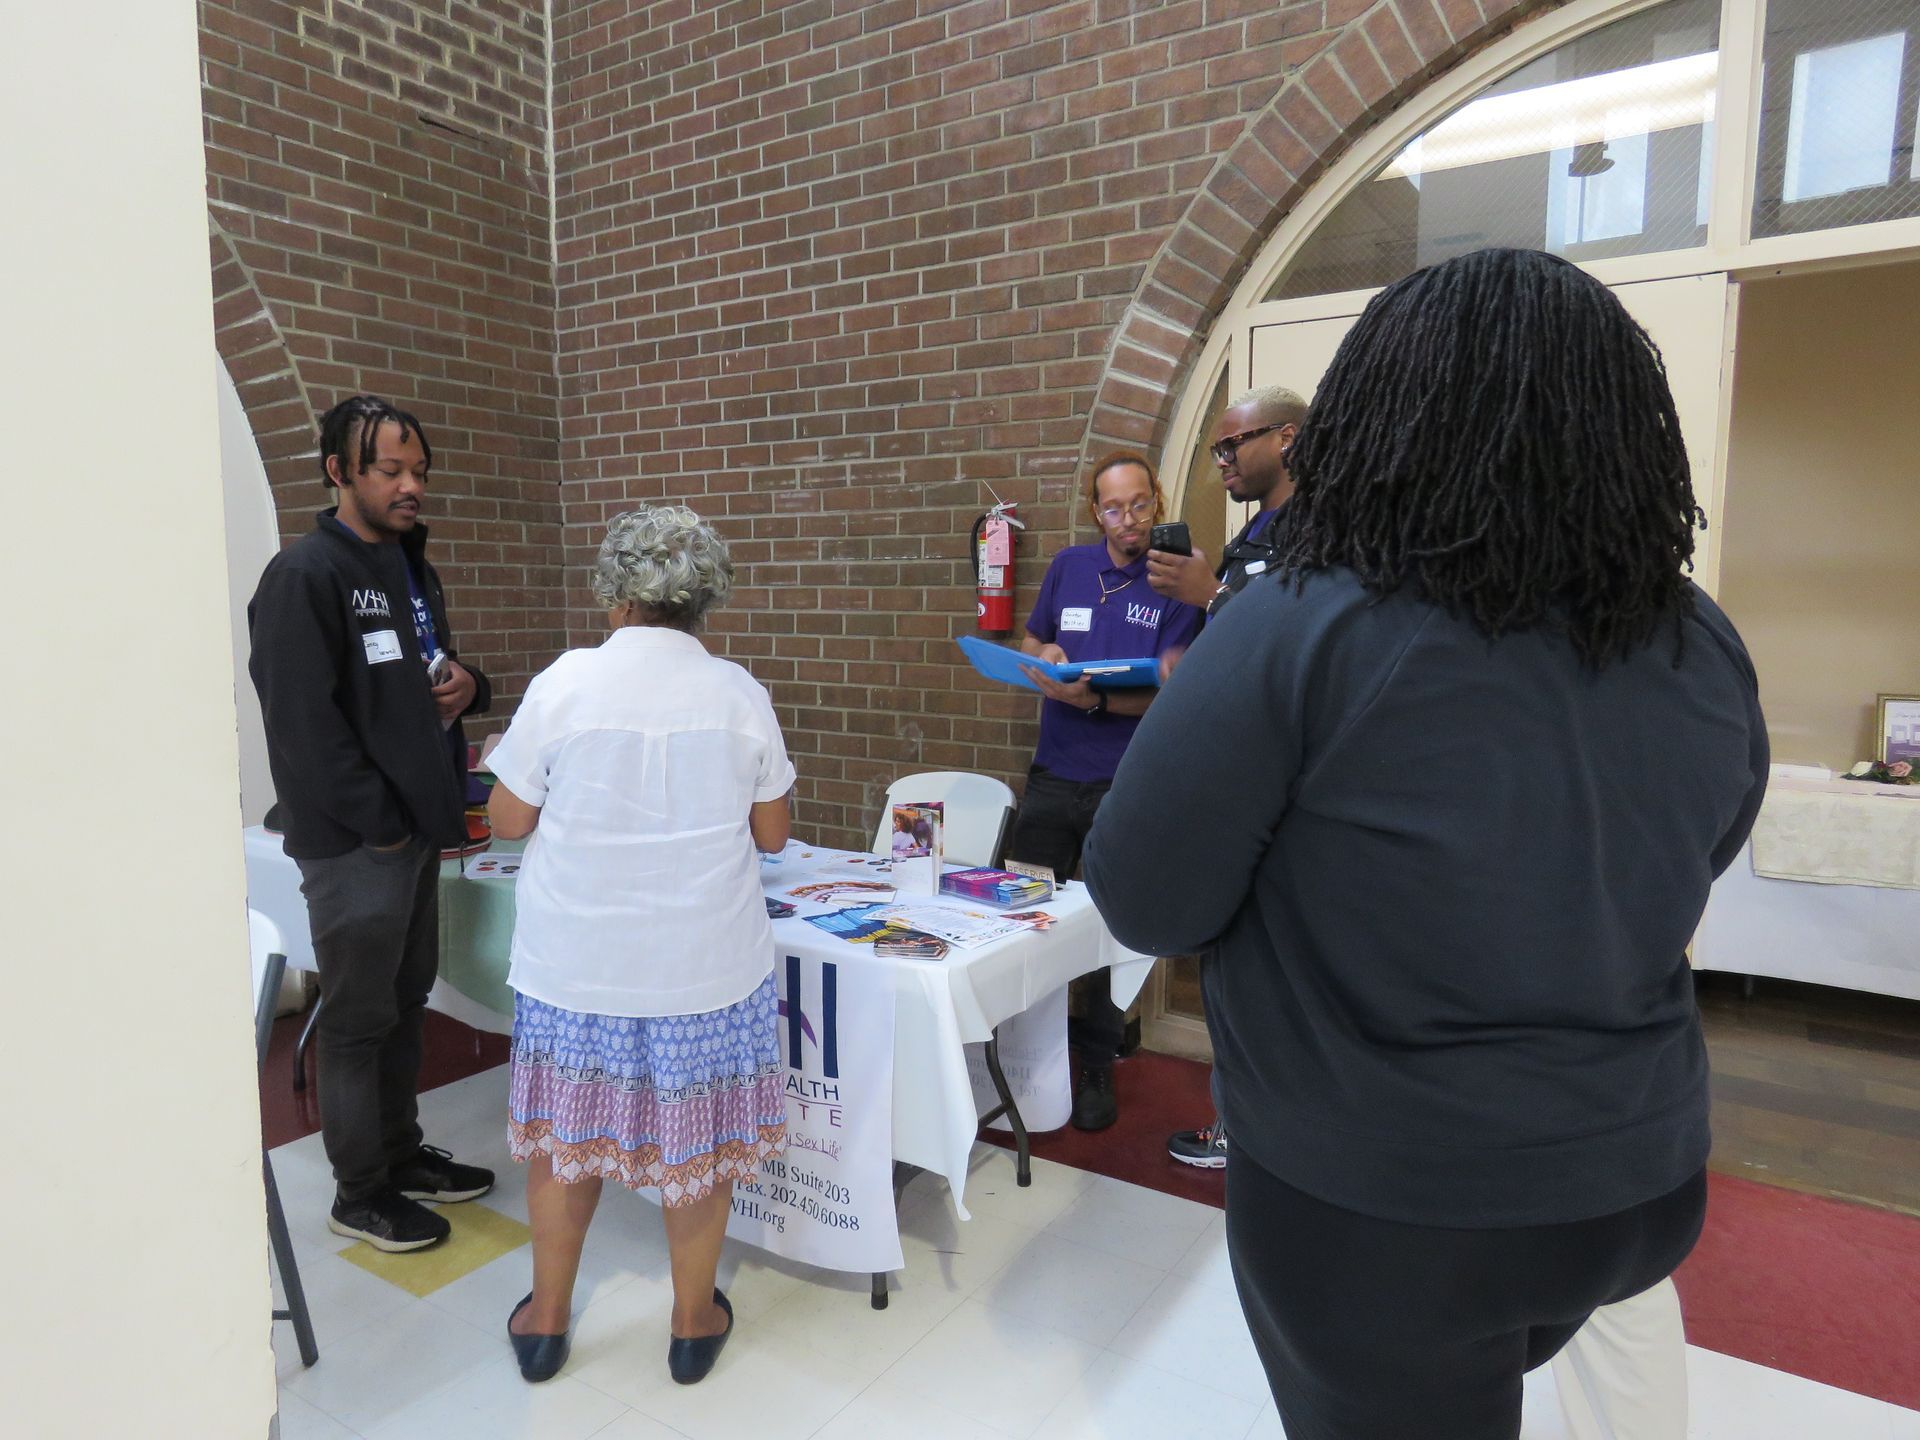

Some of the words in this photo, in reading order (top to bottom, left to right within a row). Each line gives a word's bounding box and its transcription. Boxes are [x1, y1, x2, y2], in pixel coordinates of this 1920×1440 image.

[1127, 602, 1161, 624] WHI
[785, 1074, 840, 1101] ALTH
[795, 1132, 818, 1151] Sex
[790, 1166, 824, 1193] Suite
[824, 1180, 850, 1205] 203
[770, 1183, 860, 1231] 202.450.6088
